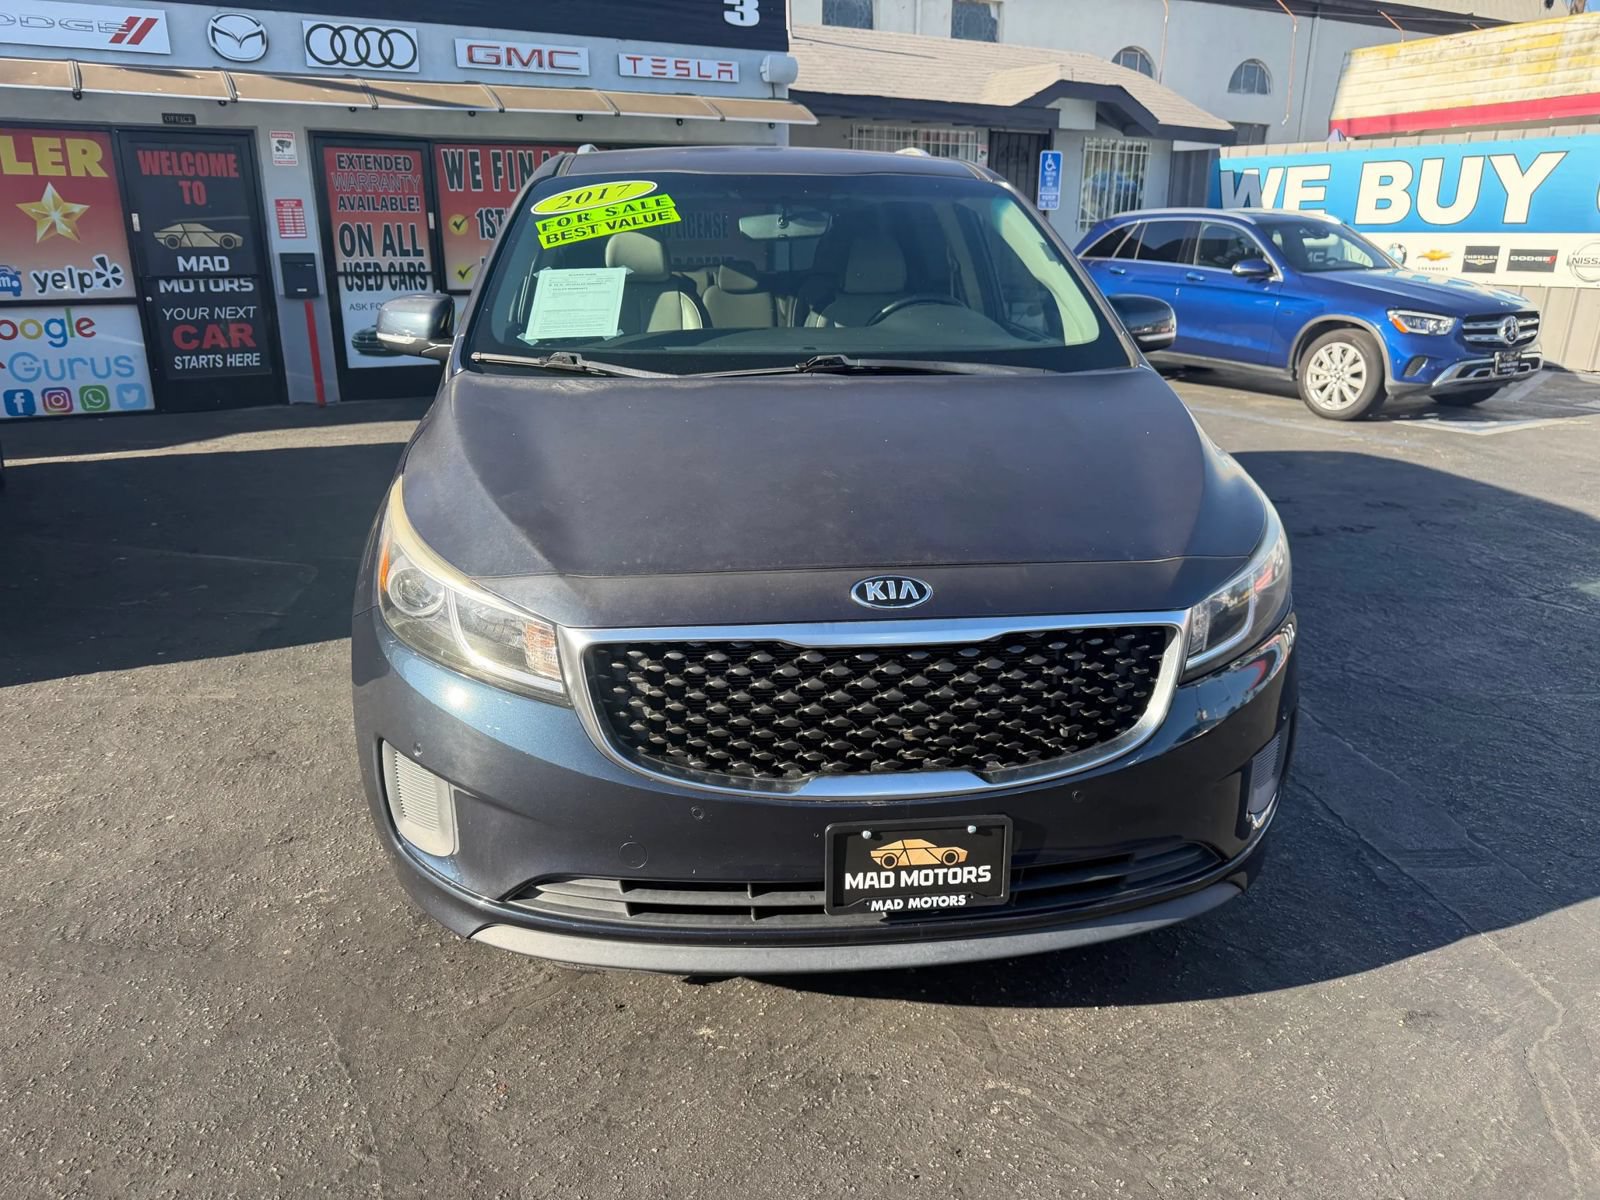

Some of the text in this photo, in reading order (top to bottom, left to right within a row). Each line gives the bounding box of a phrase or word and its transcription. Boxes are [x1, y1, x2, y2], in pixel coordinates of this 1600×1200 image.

[467, 44, 580, 71] GMC
[625, 56, 734, 81] TESLA
[137, 150, 239, 178] WELCOME
[336, 153, 413, 171] EXTENDED
[441, 148, 552, 192] WE FIN
[179, 180, 207, 206] TO
[331, 172, 420, 192] WARRANTY
[1220, 164, 1331, 213] WE
[1354, 151, 1569, 225] BUY
[337, 194, 420, 212] AVAILABLE!
[555, 184, 632, 210] 2017
[475, 207, 505, 240] 1ST
[542, 197, 669, 232] FOR SALE
[546, 223, 599, 244] BEST
[605, 210, 672, 231] VALUE
[339, 222, 375, 258] ON
[381, 222, 425, 258] ALL
[177, 255, 230, 272] MAD
[343, 261, 428, 291] USED CARS
[32, 267, 94, 293] yelp
[159, 278, 254, 293] MOTORS
[162, 306, 257, 321] YOUR NEXT
[349, 302, 384, 311] ASK FO
[172, 323, 256, 350] CAR
[174, 353, 261, 370] STARTS HERE
[864, 580, 920, 601] KIA
[845, 865, 992, 890] MAD MOTORS
[870, 895, 966, 911] MAD MOTORS
